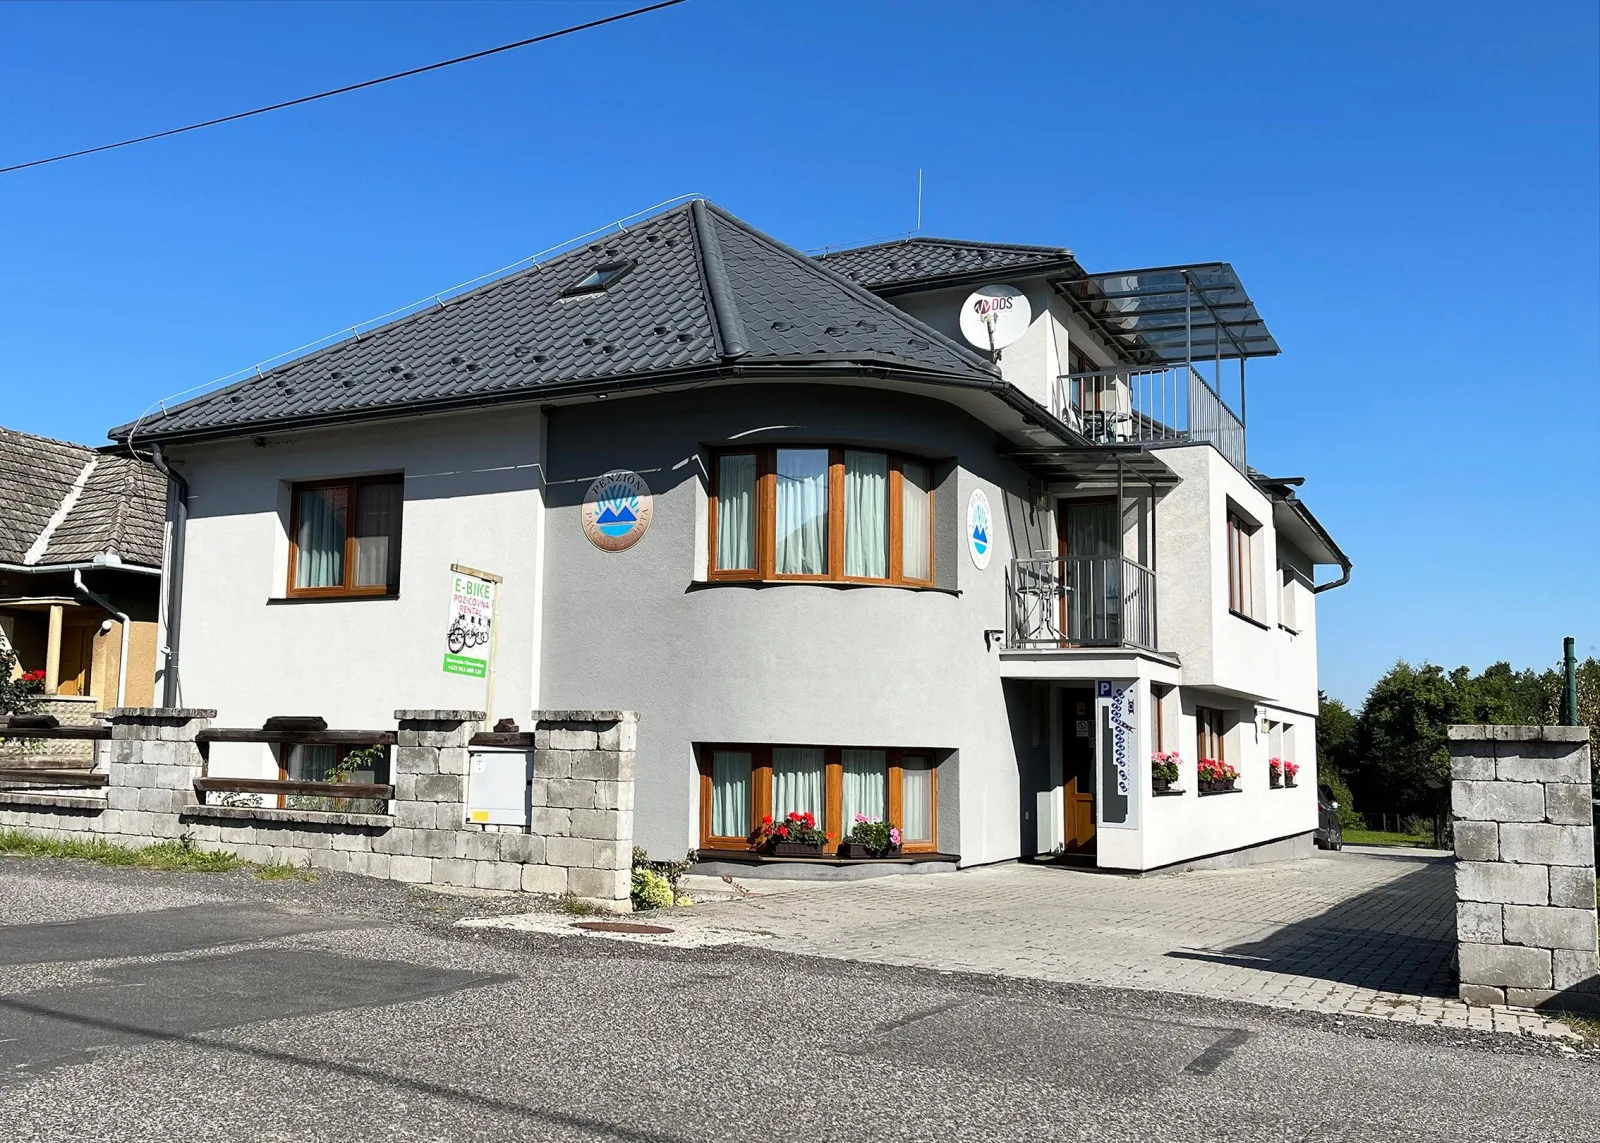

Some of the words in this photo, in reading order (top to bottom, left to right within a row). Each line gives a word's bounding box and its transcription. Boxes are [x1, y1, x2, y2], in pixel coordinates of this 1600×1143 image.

[992, 296, 1013, 311] DDS
[592, 473, 643, 495] PENZIÓN
[455, 578, 490, 599] E-BIKE
[459, 604, 482, 616] RENTAL
[1100, 682, 1110, 695] P
